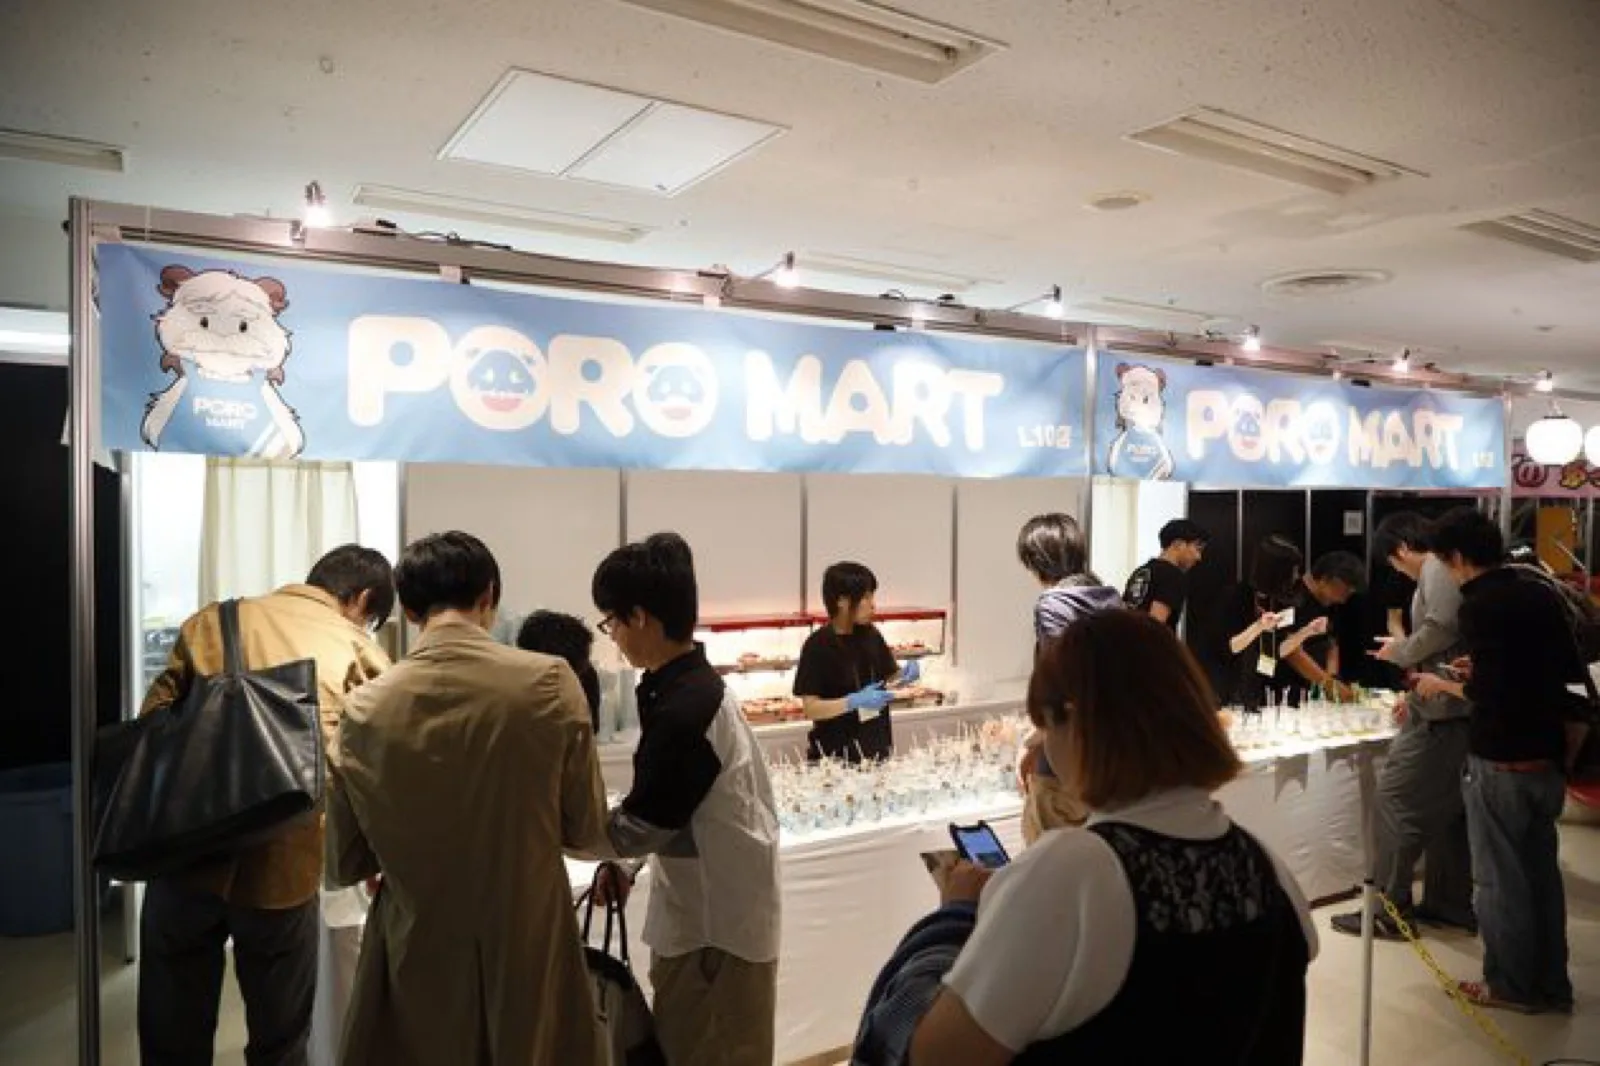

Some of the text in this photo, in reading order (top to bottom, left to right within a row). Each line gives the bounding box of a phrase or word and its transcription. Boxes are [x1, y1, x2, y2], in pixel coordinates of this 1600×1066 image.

[193, 397, 258, 419] PORO
[348, 315, 1003, 450] PORO MART
[1186, 390, 1463, 469] PORO MART
